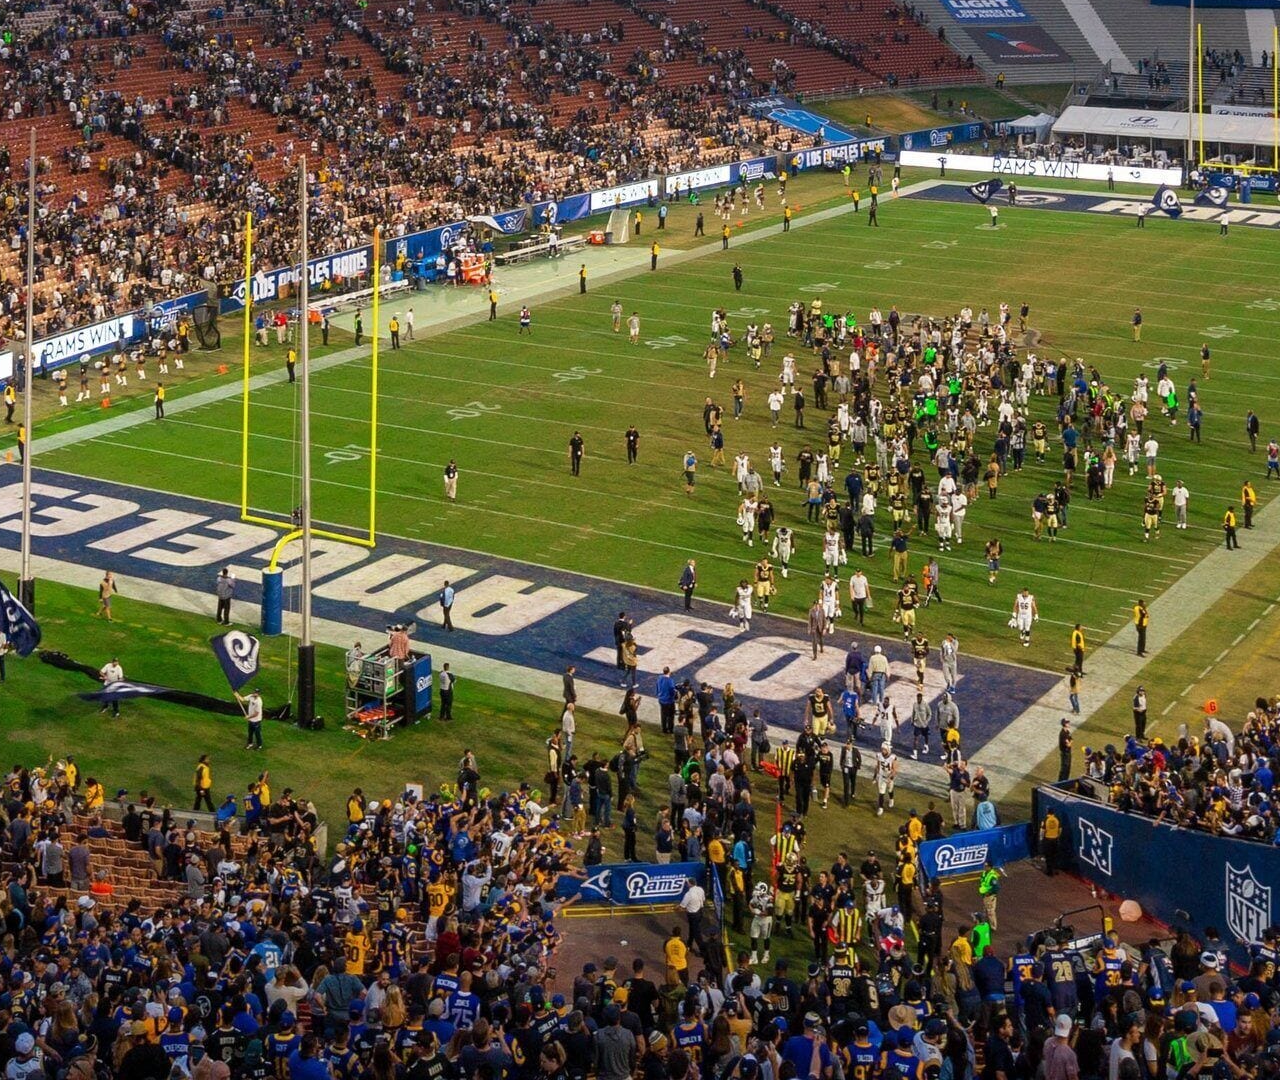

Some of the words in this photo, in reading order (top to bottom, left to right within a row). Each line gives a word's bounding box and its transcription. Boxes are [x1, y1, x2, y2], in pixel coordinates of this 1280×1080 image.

[949, 0, 1009, 8] LIGHT
[807, 150, 821, 166] LOS
[993, 158, 1036, 176] RAMS
[1043, 161, 1079, 178] WIN!
[332, 250, 368, 275] RAMS
[46, 332, 85, 360] RAMS
[446, 401, 502, 418] 20
[935, 844, 988, 871] Rams
[1079, 817, 1113, 876] N
[627, 872, 687, 898] Rams
[1231, 895, 1268, 943] NFL
[265, 950, 279, 969] 21
[832, 977, 853, 997] 30
[1106, 969, 1121, 986] 30
[450, 1007, 475, 1032] 75
